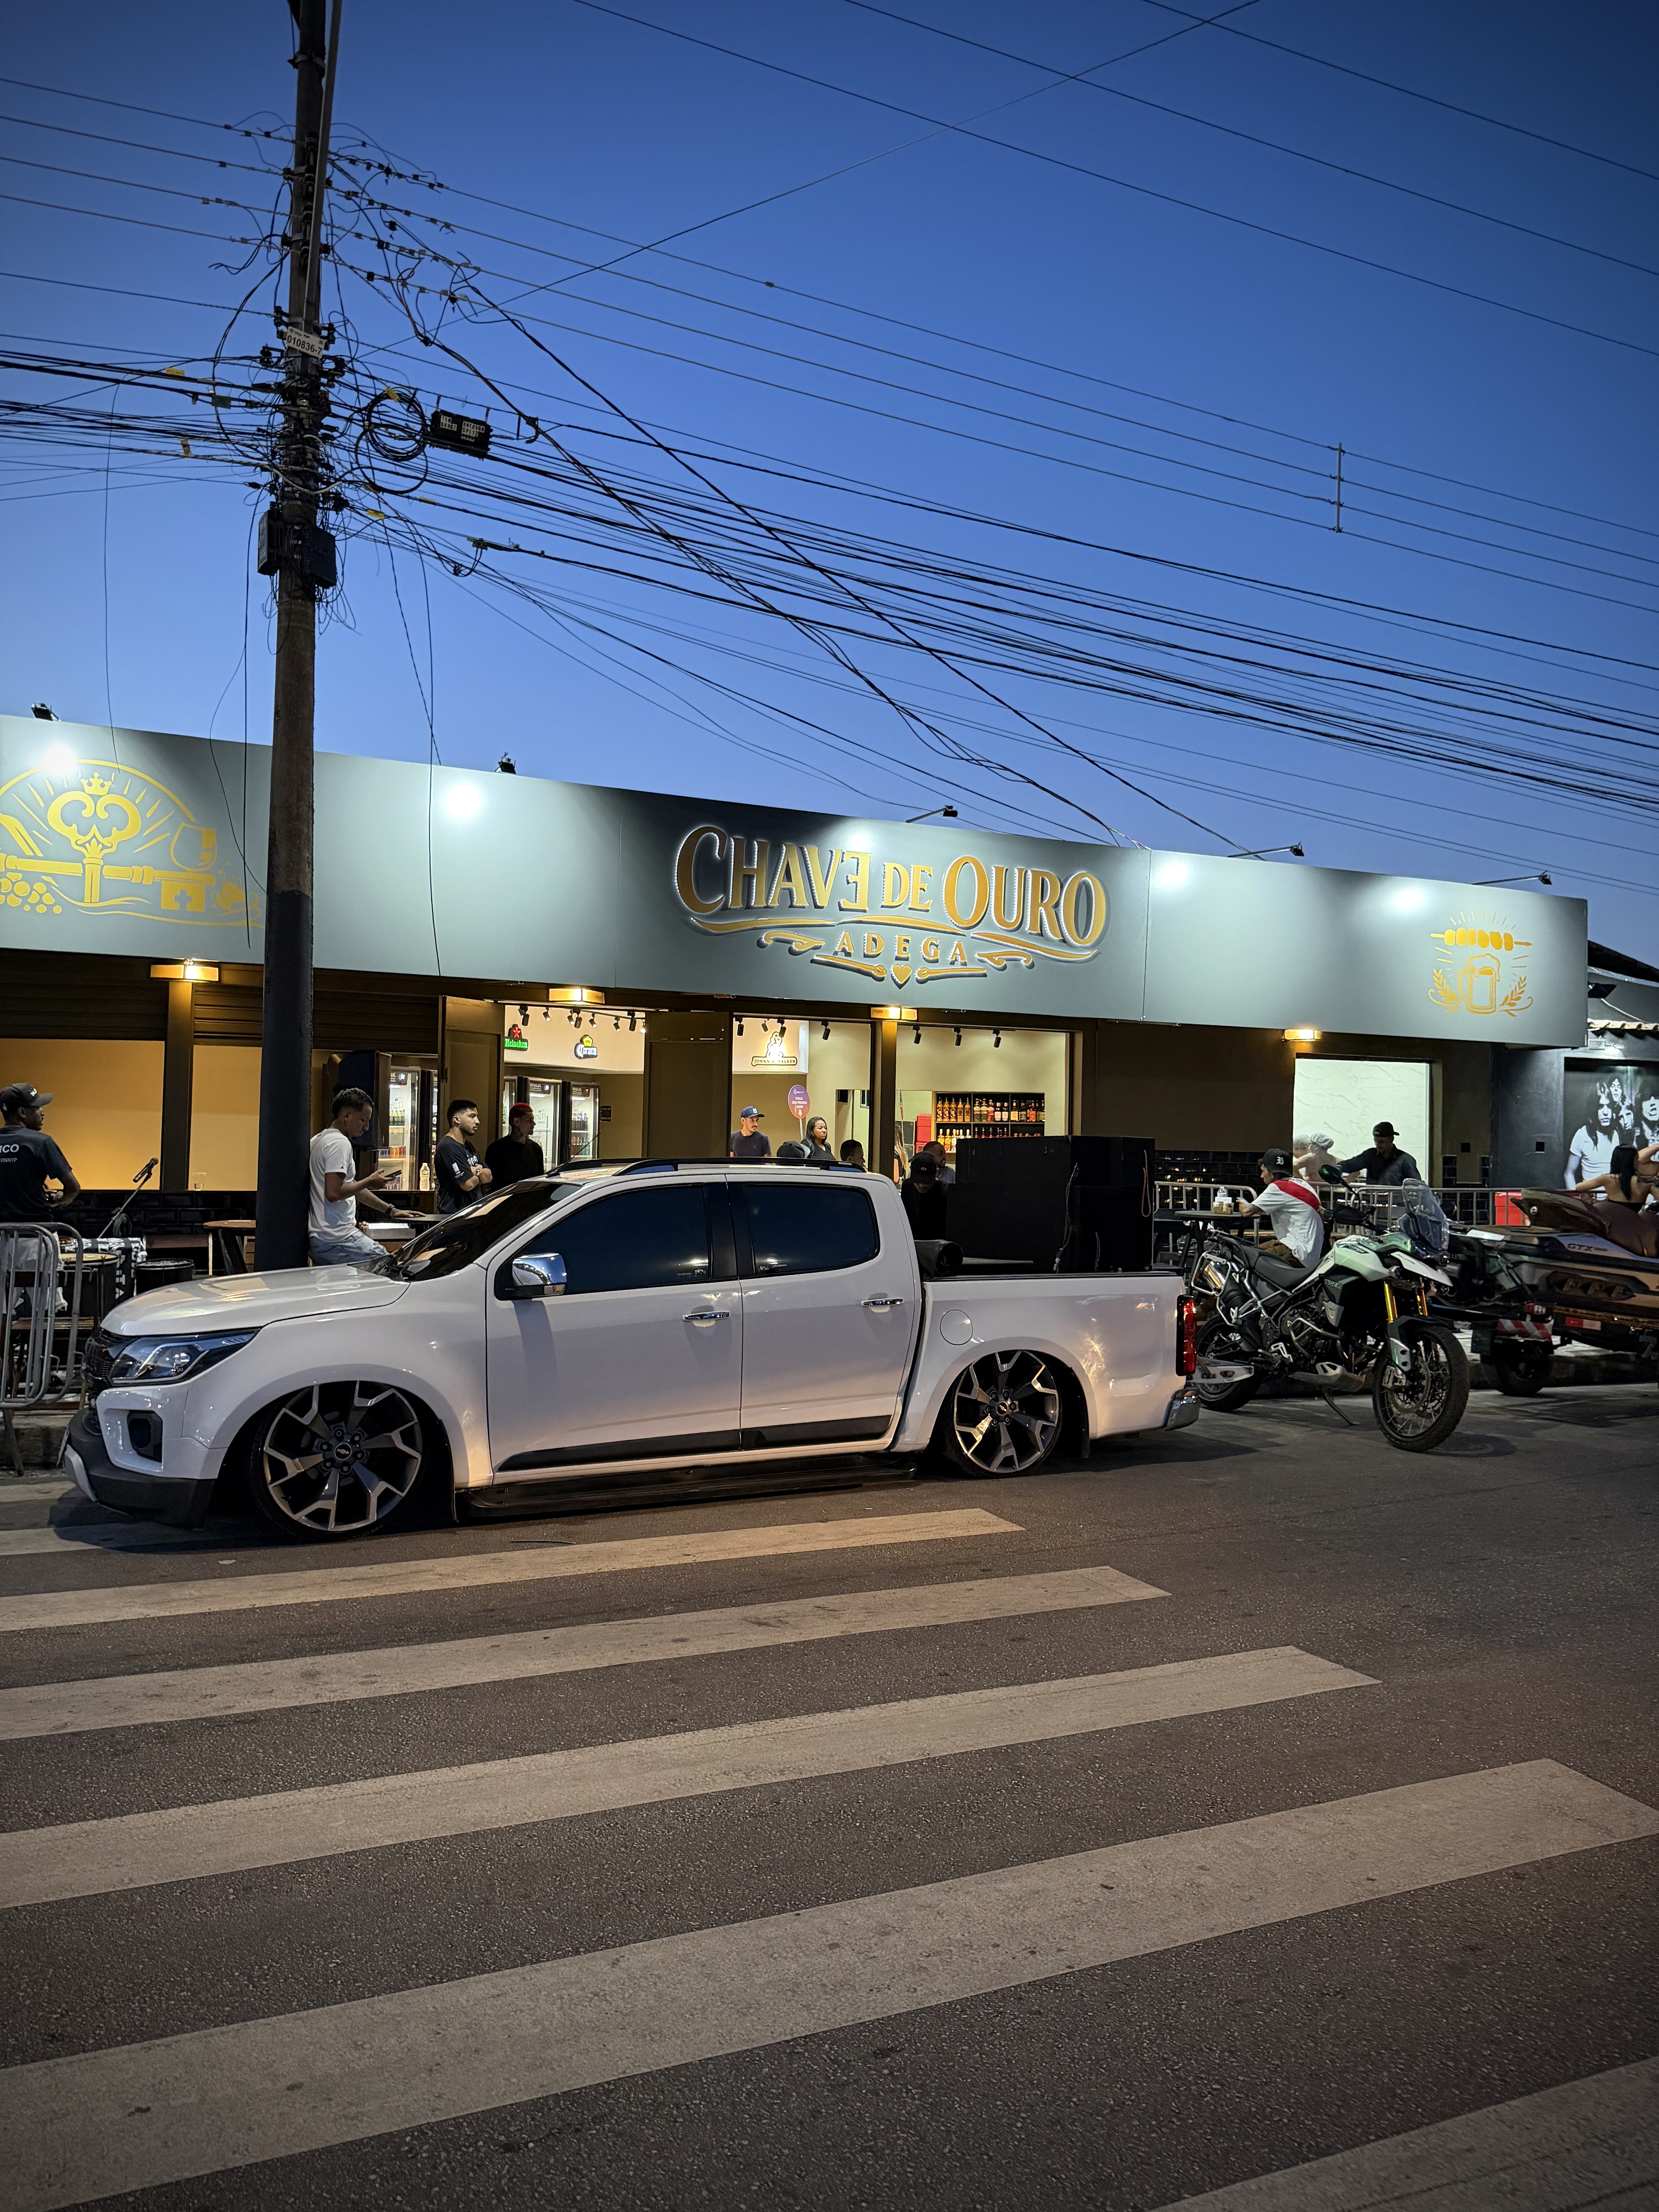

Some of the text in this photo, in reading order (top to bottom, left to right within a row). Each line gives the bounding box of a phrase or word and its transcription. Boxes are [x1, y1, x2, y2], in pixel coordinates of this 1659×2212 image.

[287, 335, 323, 355] 010836-7
[675, 826, 1108, 946] CHAVE DE OURO
[835, 931, 967, 964] ADEGA
[505, 1039, 527, 1048] Heineken
[1568, 1243, 1594, 1252] GTX
